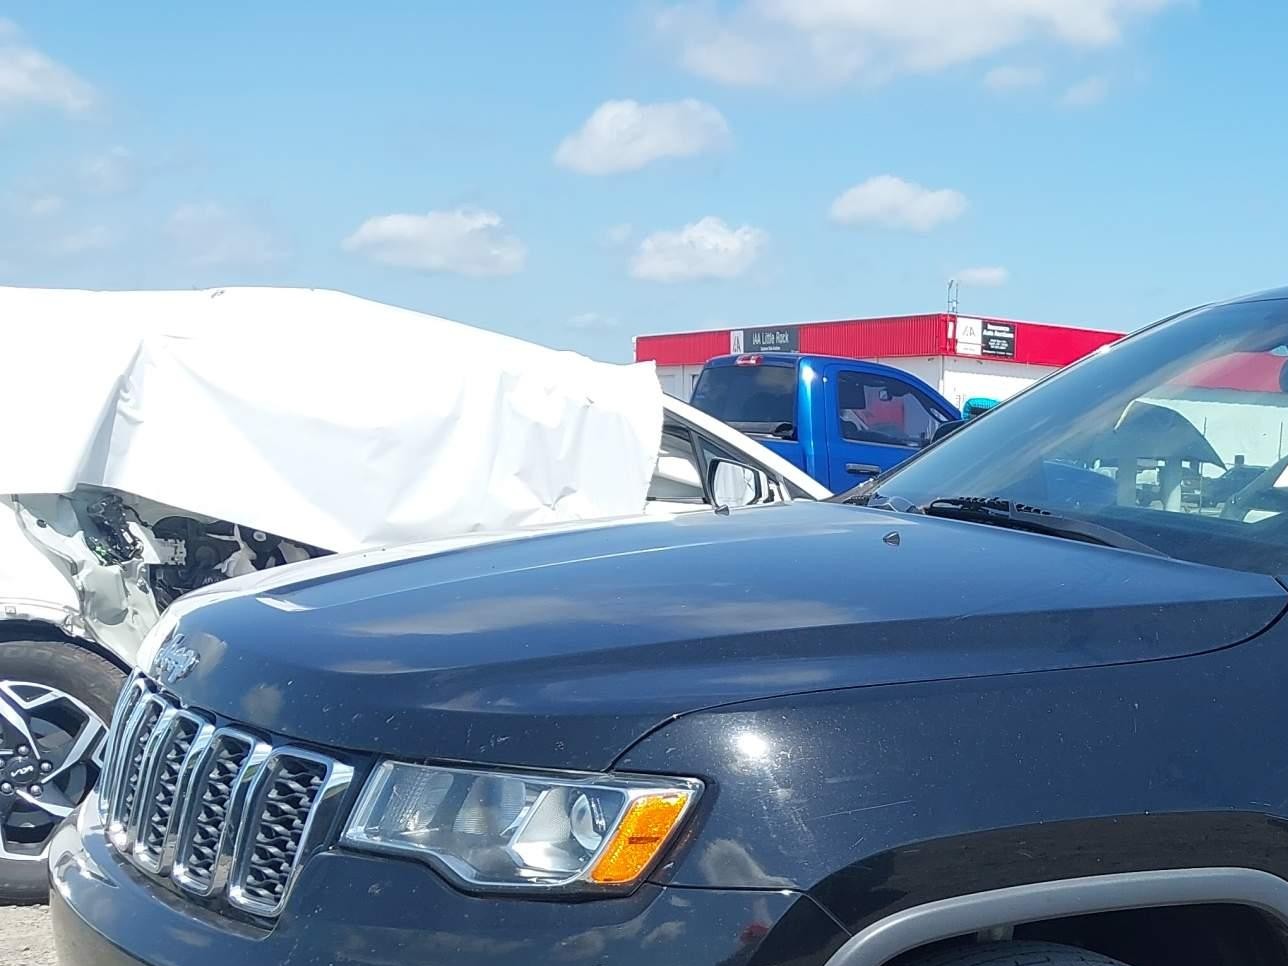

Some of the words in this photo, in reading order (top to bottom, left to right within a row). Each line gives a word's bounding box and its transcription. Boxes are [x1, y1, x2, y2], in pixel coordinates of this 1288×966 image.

[753, 332, 761, 345] IAA
[762, 331, 775, 345] Little
[776, 330, 789, 344] Rock
